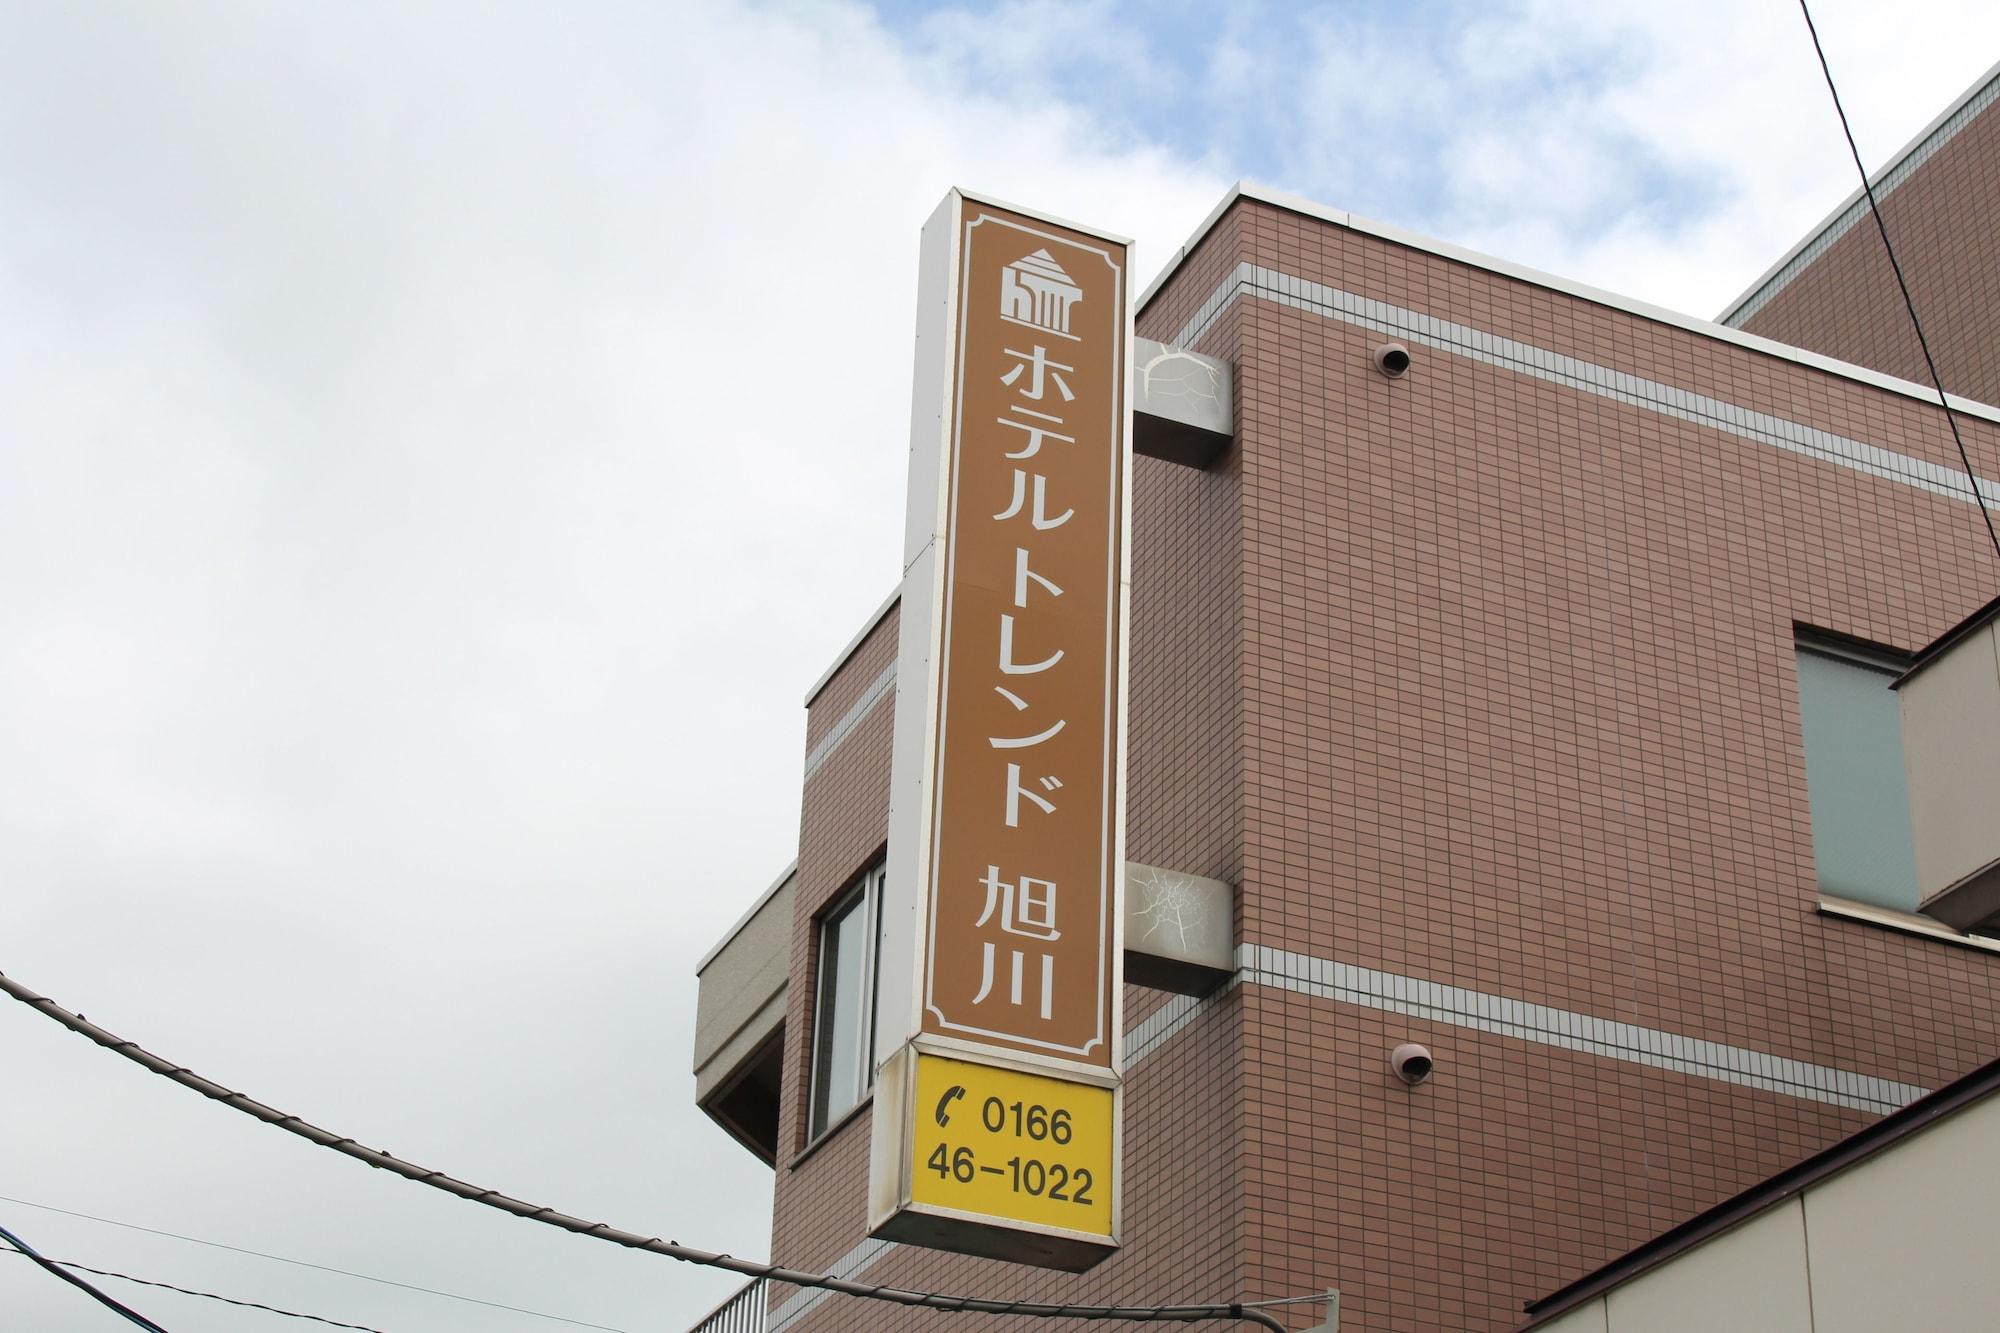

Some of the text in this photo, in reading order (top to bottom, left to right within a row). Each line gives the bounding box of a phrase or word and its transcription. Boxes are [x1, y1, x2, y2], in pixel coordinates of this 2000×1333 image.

[972, 344, 1077, 1020] ホテルトレンド 旭川
[982, 1096, 1073, 1146] 0166
[927, 1142, 1093, 1206] 46-1022
